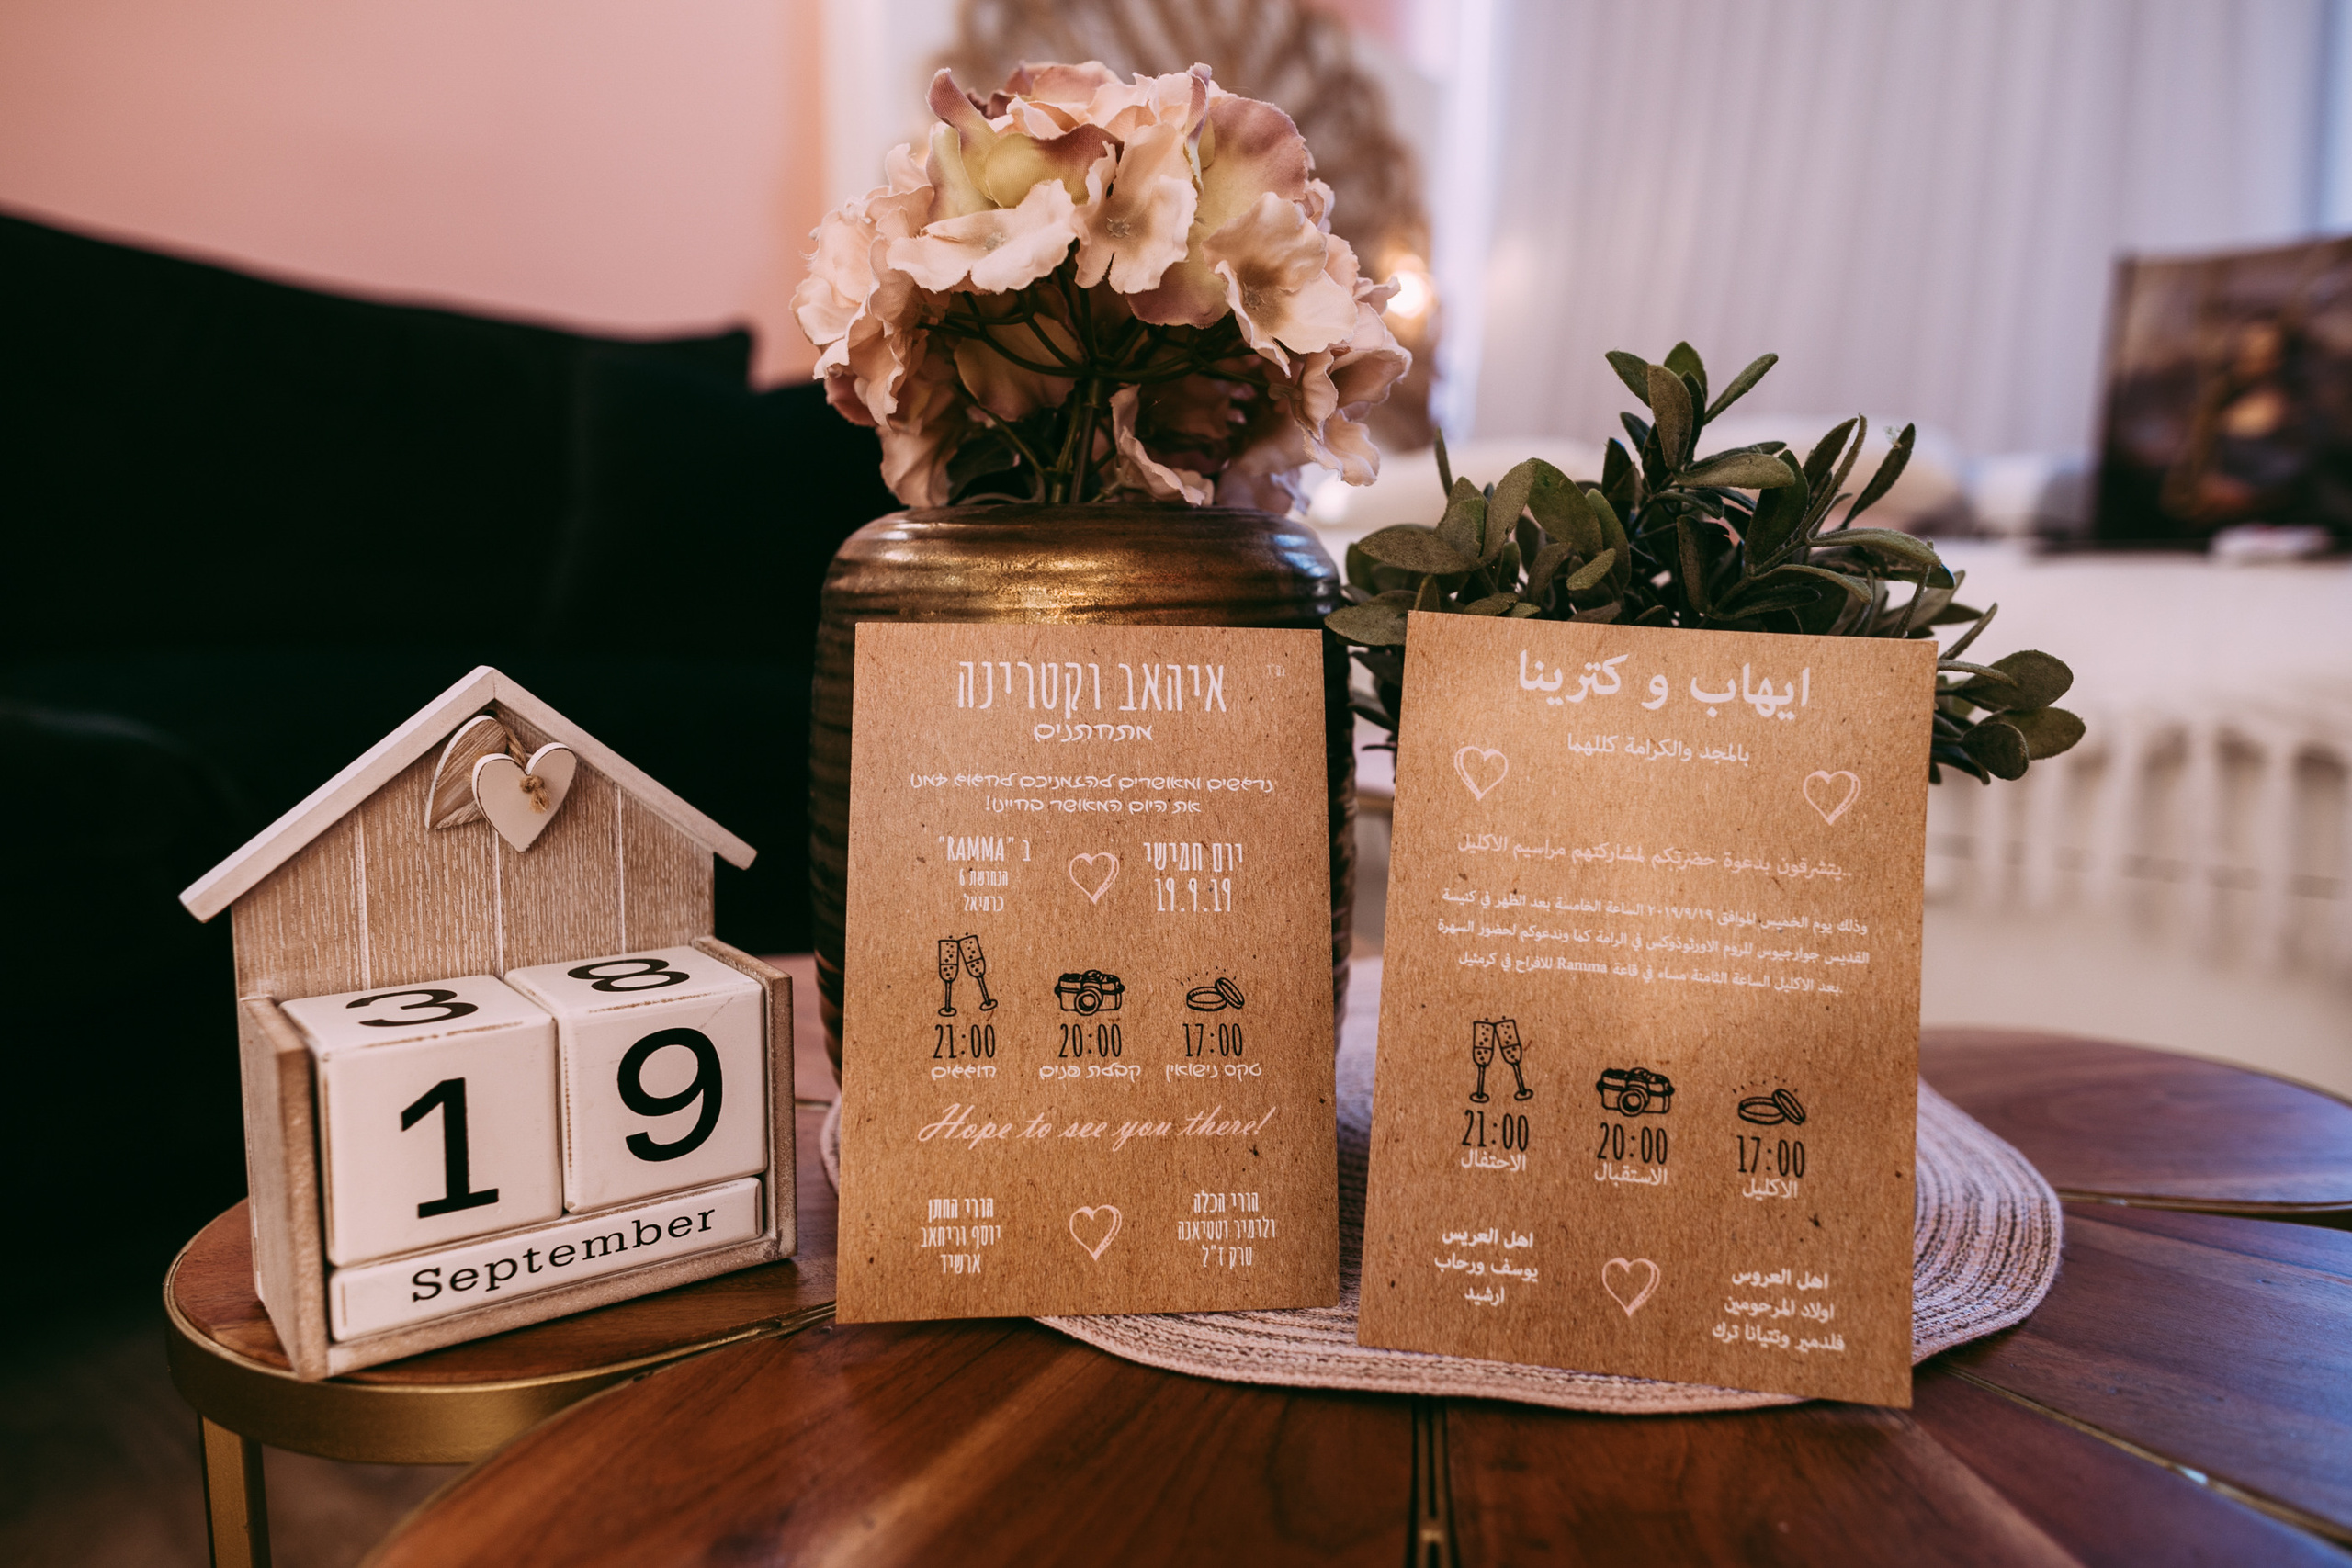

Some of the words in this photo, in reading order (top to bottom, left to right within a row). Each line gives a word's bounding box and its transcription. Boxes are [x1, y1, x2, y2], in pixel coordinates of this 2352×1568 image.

[1118, 663, 1227, 713] איהאב
[1519, 649, 1628, 706] كترينا
[957, 661, 1101, 719] וקטרינה
[1641, 672, 1668, 709] و
[1690, 663, 1810, 721] ايهاب
[1034, 724, 1153, 742] מתחתנים
[910, 773, 948, 789] עמנו
[954, 773, 1018, 787] לחגוג
[1118, 776, 1201, 791] ומאושרים
[1206, 777, 1273, 792] נרגשים
[985, 795, 1044, 813] בחיינו!
[1050, 799, 1122, 813] המאושר
[1128, 799, 1168, 815] היום
[1172, 800, 1201, 814] את
[938, 835, 1014, 862] "RAMMA"
[1022, 839, 1031, 862] ב
[1143, 842, 1203, 872] חמישי
[1212, 842, 1243, 873] יום
[1512, 839, 1566, 861] مراسيم
[1723, 852, 1770, 875] بدعوة
[963, 892, 1005, 912] כרמיאל
[1154, 877, 1231, 912] 19.9.19
[1442, 887, 1477, 906] كنيسة
[1494, 893, 1526, 908] الظهر
[1555, 896, 1601, 912] الخامسة
[1530, 899, 1551, 912] بعد
[1605, 900, 1644, 917] الساعة
[1437, 918, 1475, 935] السهرة
[1477, 924, 1516, 938] لحضور
[1758, 915, 1808, 931] الخميس
[1812, 919, 1833, 937] يوم
[1556, 956, 1609, 974] Ramma
[933, 1023, 996, 1059] 21:00
[1058, 1023, 1123, 1058] 20:00
[1182, 1022, 1243, 1057] 17:00
[931, 1064, 997, 1081] חוגגים
[1039, 1065, 1081, 1080] פנים
[1085, 1062, 1141, 1083] קבלת
[1165, 1063, 1219, 1083] נישואין
[1224, 1062, 1262, 1082] טקס
[918, 1103, 1012, 1150] Hope
[1016, 1112, 1051, 1139] to
[1057, 1122, 1109, 1139] see
[1111, 1121, 1170, 1152] you
[1177, 1104, 1277, 1137] there!
[1462, 1109, 1529, 1152] 21:00
[1597, 1122, 1668, 1165] 20:00
[1460, 1148, 1527, 1172] الاحتفال
[1736, 1134, 1806, 1179] 17:00
[1594, 1162, 1668, 1187] الاستقبال
[928, 1197, 958, 1223] החתן
[964, 1197, 994, 1219] הורי
[1193, 1189, 1226, 1213] הכלה
[1230, 1191, 1259, 1213] הורי
[971, 1224, 1001, 1250] יוסף
[1442, 1226, 1499, 1247] العريس
[1504, 1230, 1534, 1248] اهل
[411, 1207, 716, 1303] September
[940, 1253, 982, 1274] ארשיד
[1228, 1246, 1253, 1270] טרק
[1489, 1258, 1539, 1283] يوسف
[1731, 1268, 1792, 1288] العروس
[1796, 1270, 1829, 1291] اهل
